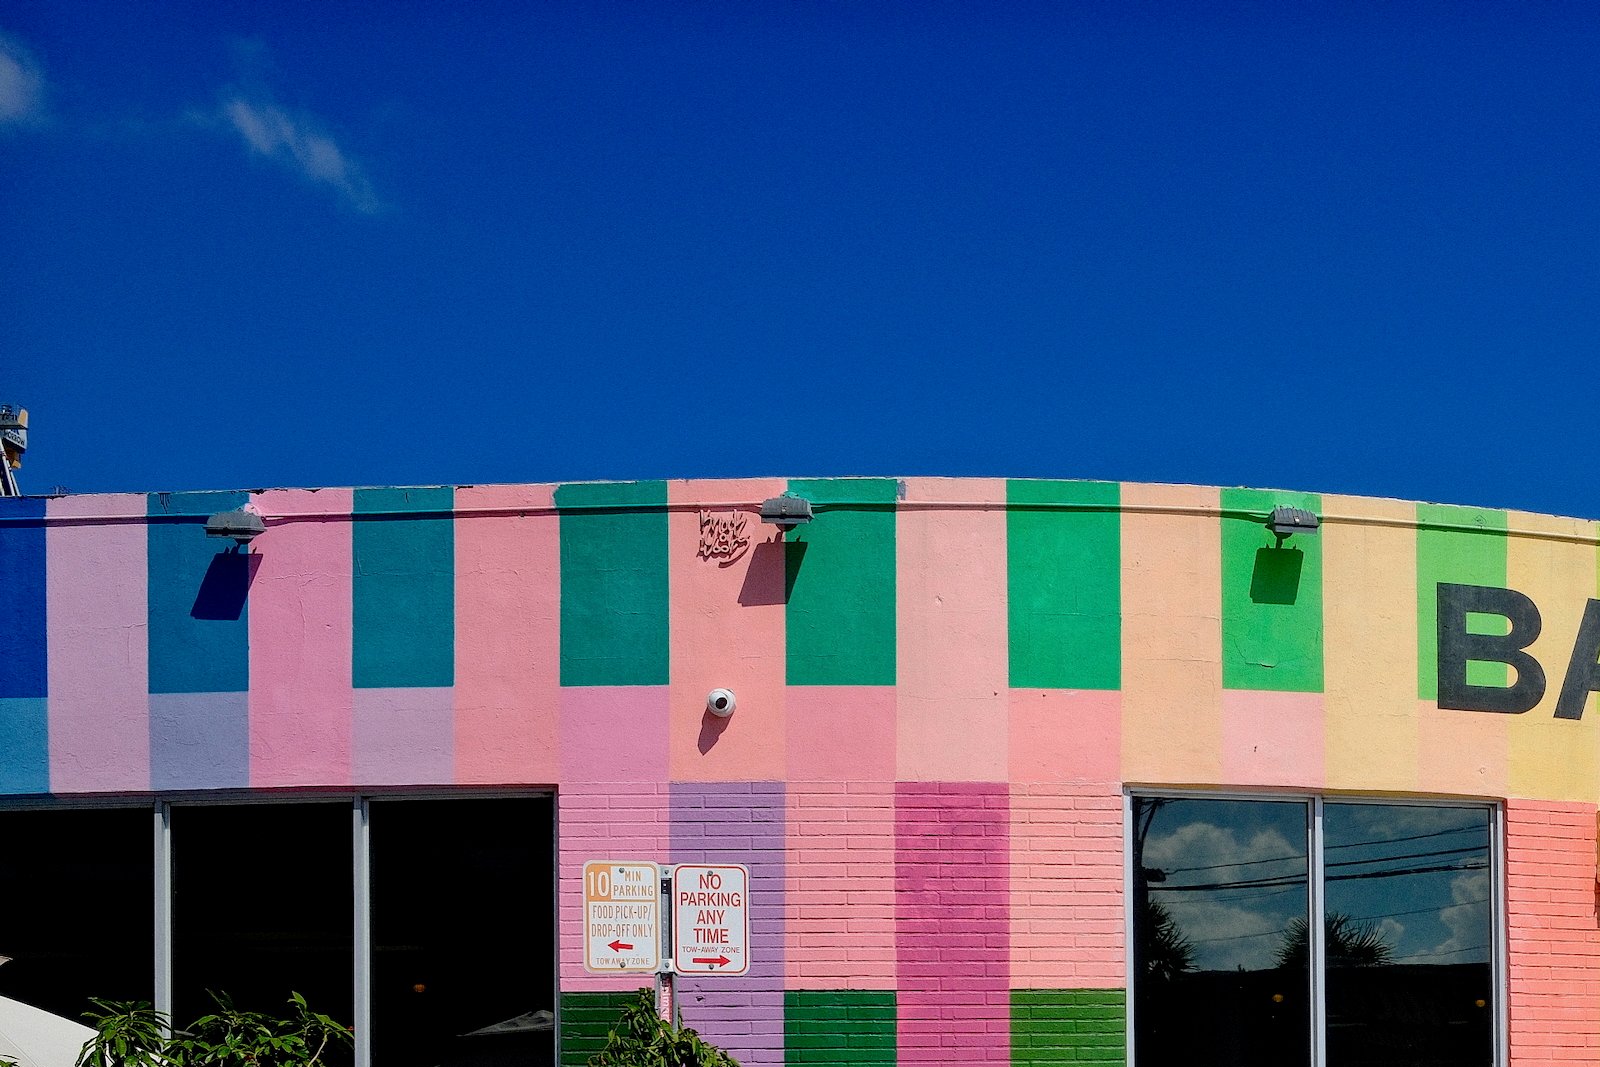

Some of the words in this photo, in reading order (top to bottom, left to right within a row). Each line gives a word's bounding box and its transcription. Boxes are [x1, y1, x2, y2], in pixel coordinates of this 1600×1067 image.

[624, 871, 641, 882] MIN
[699, 873, 722, 890] NO
[588, 871, 610, 898] 10
[613, 885, 654, 897] PARKING
[680, 892, 741, 907] PARKING
[592, 905, 613, 919] FOOD
[615, 905, 652, 921] PICK-UP/
[696, 909, 725, 925] ANY
[591, 924, 631, 938] DROP-OFF
[632, 923, 653, 938] ONLY
[693, 928, 729, 944] TIME
[681, 945, 719, 954] TOW-AWAY
[721, 945, 741, 954] ZONE
[596, 957, 610, 965] TOW
[611, 957, 631, 966] AWAY
[631, 957, 650, 965] ZONE
